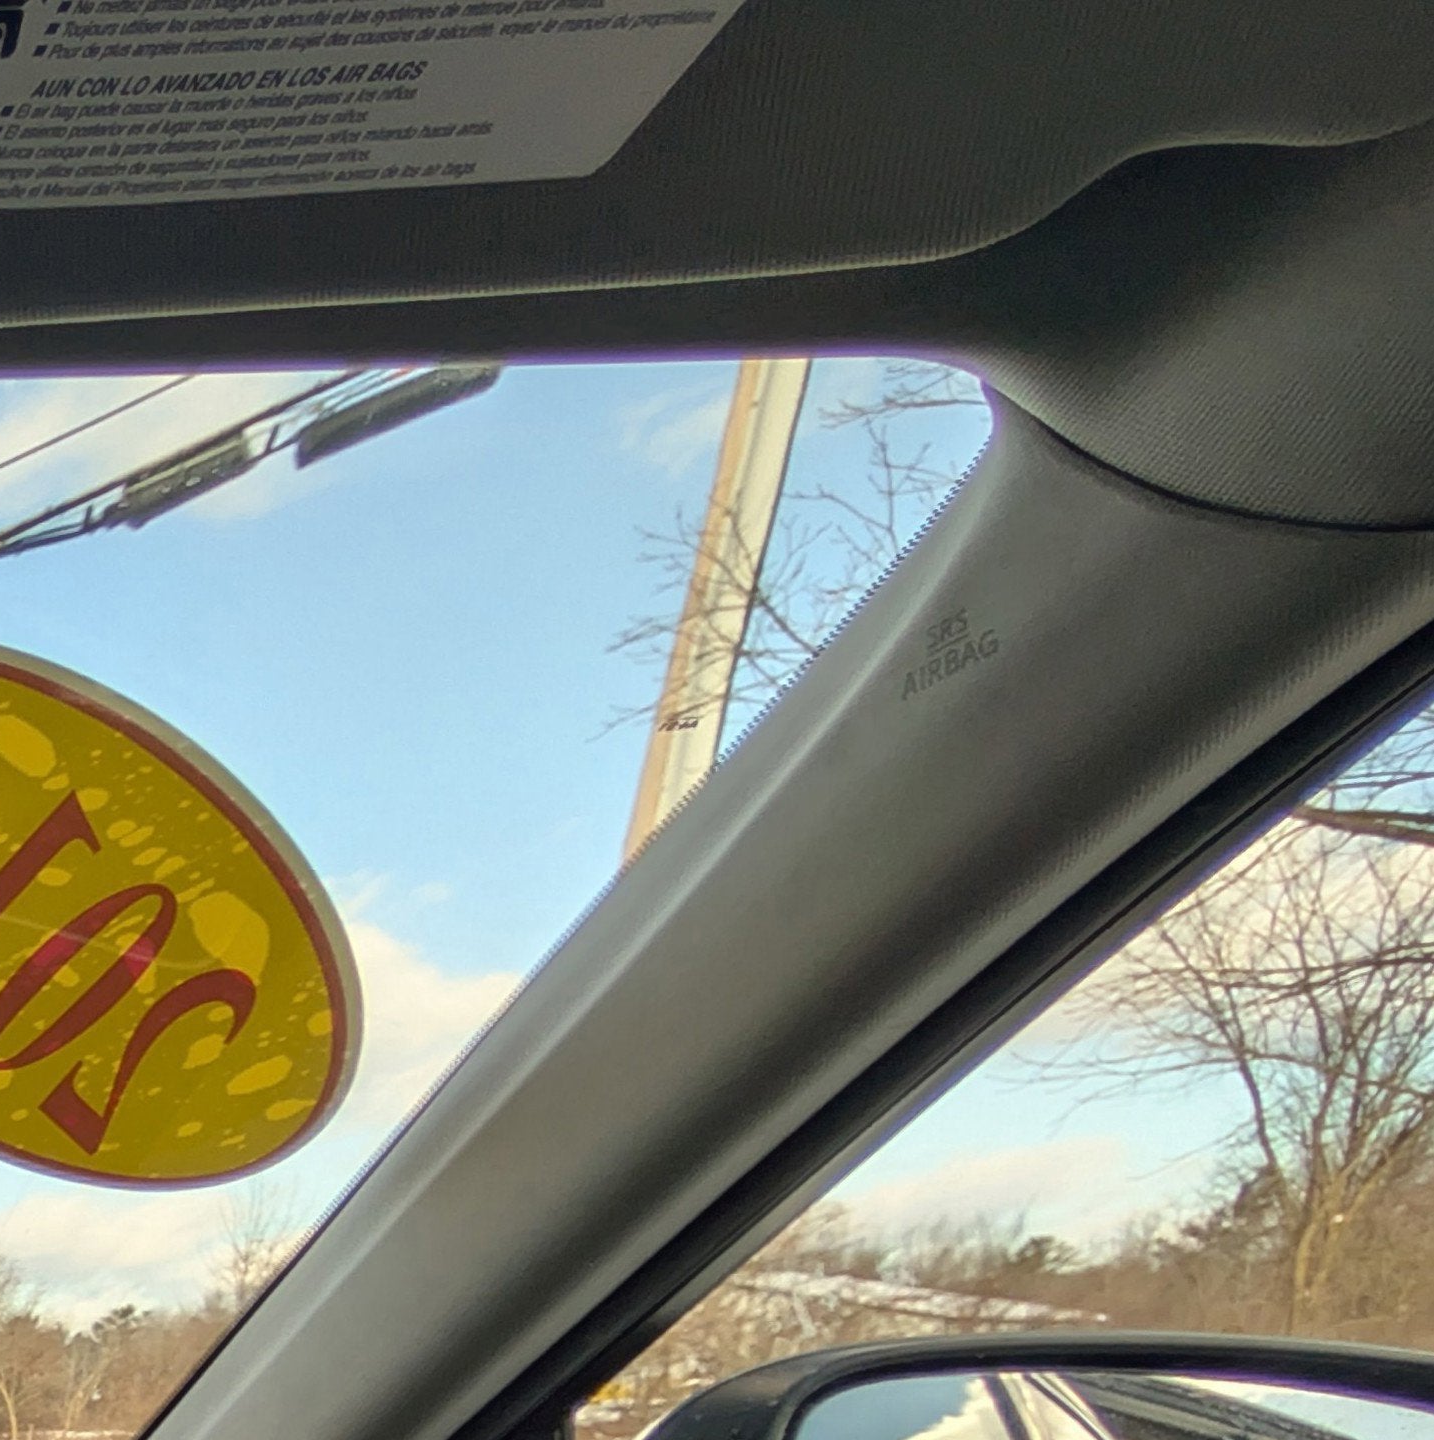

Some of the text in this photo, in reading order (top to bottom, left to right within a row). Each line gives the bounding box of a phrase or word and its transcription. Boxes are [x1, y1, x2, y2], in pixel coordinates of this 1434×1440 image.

[31, 61, 428, 98] AUN CON LO AVANZADO EN LOS AIR BAGS
[925, 607, 969, 646] SRS
[902, 629, 998, 700] AIRBAG
